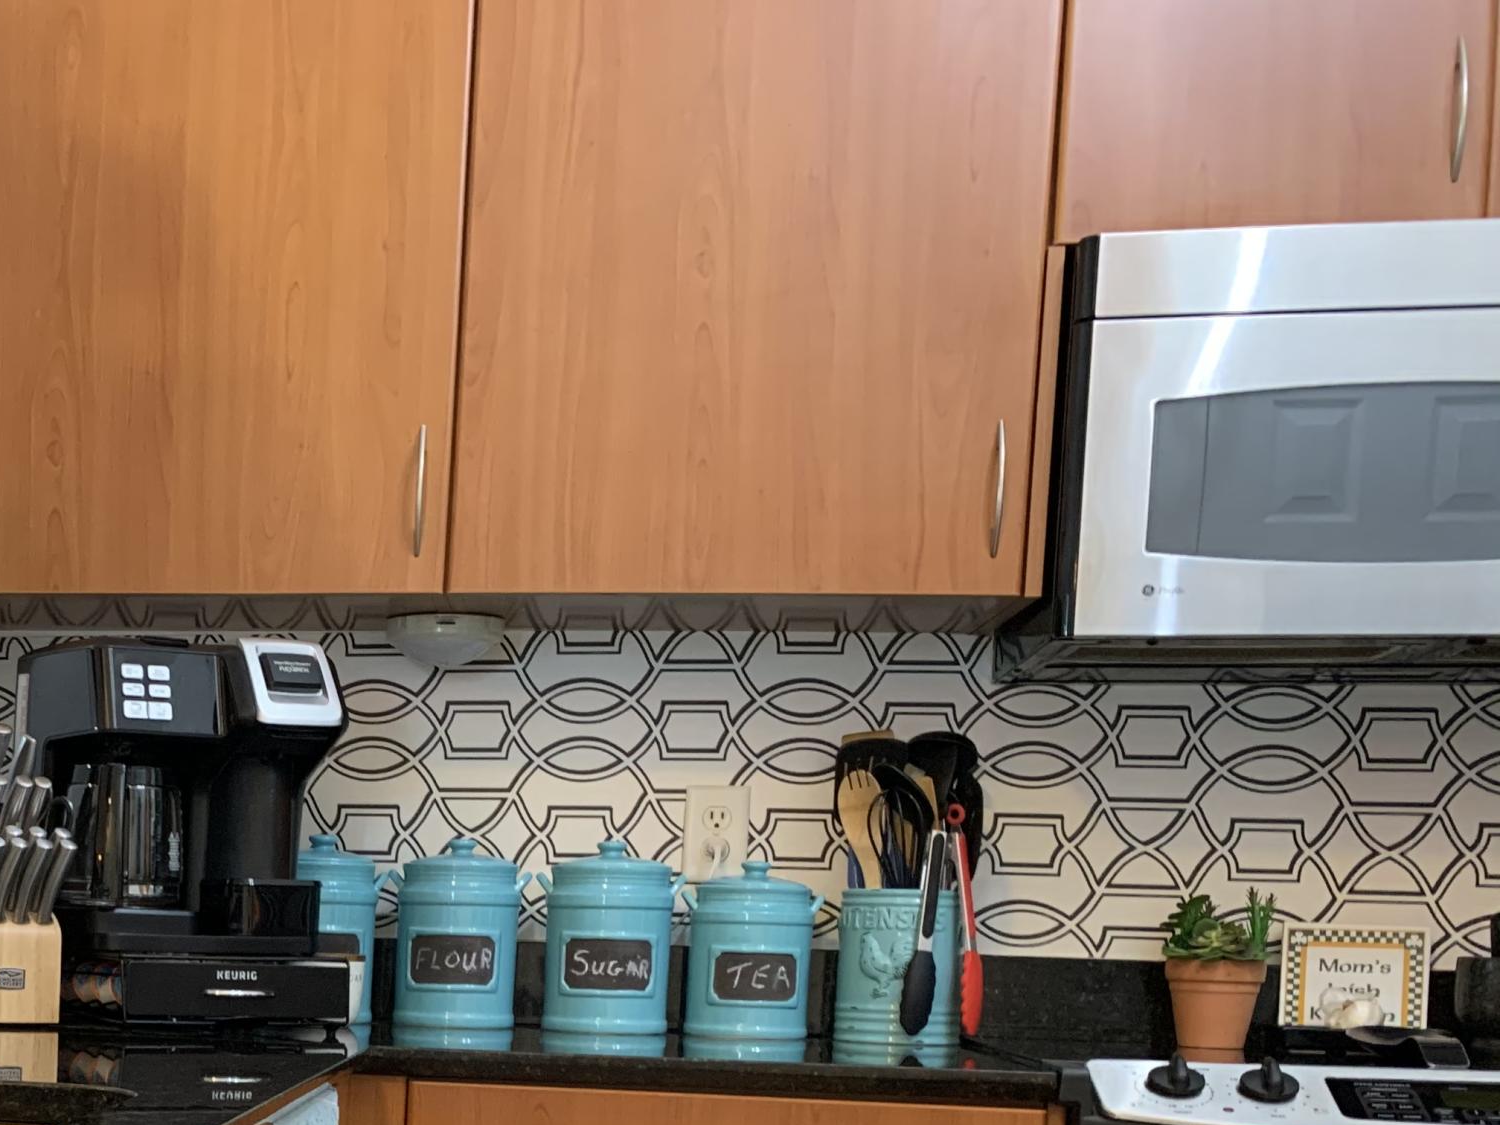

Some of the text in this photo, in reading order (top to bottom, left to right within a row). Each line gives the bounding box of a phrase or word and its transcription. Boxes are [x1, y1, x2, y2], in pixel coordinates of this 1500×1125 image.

[842, 906, 946, 931] UTENSIS
[415, 947, 492, 971] FLOUR
[1319, 958, 1392, 974] Mom's
[216, 969, 258, 981] KEURIG
[726, 962, 791, 990] TEA
